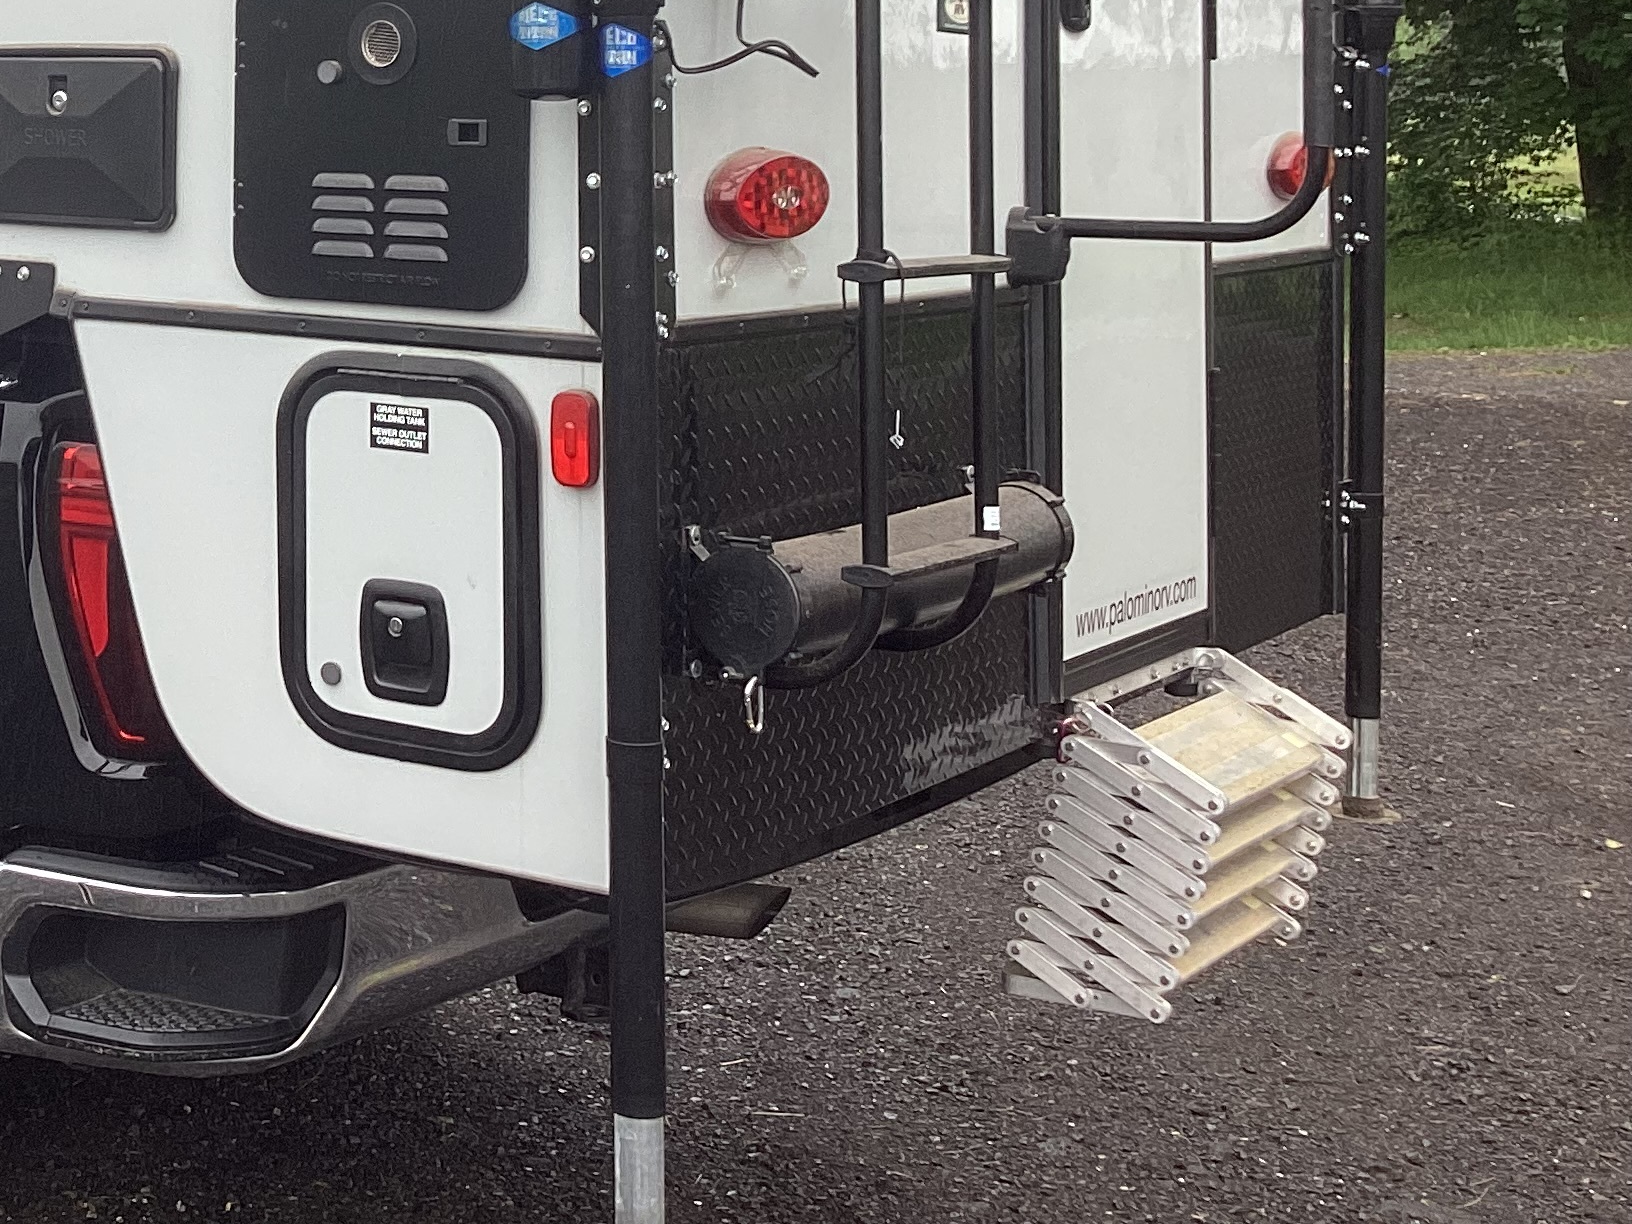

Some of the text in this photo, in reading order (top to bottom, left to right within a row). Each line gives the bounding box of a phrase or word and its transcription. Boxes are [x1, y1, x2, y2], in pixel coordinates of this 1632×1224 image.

[376, 404, 423, 417] GRAY WATER
[373, 413, 426, 426] HOLDING TANK
[371, 426, 428, 440] SEWER OUTLET
[376, 436, 423, 448] CONNECTION
[1075, 576, 1197, 637] www.palominorv.com
